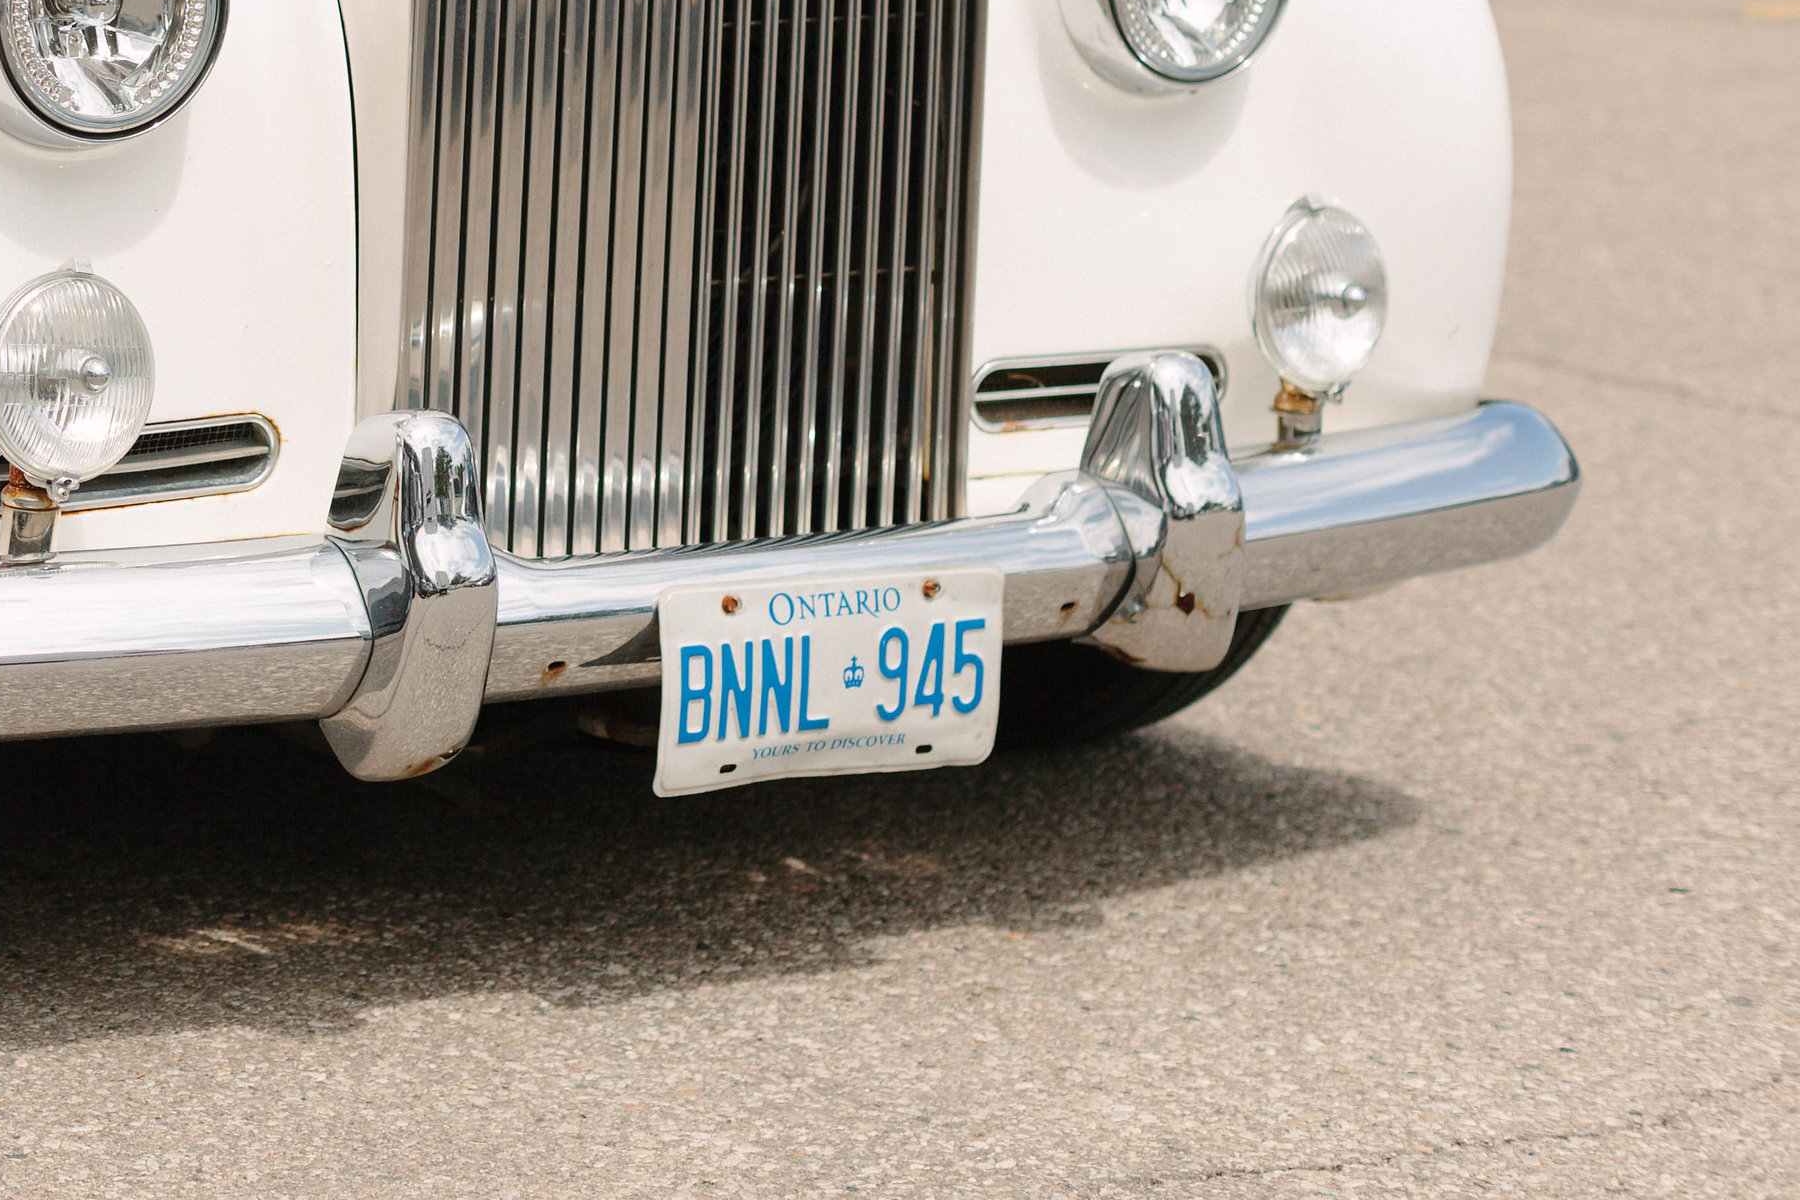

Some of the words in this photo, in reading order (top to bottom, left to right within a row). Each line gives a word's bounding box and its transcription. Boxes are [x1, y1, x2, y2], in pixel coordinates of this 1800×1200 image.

[768, 587, 901, 626] ONTARIO
[677, 634, 829, 744] BNNL
[876, 618, 985, 721] 945
[752, 742, 801, 760] YOURS
[806, 739, 825, 752] TO
[830, 733, 906, 750] DISCOVER
